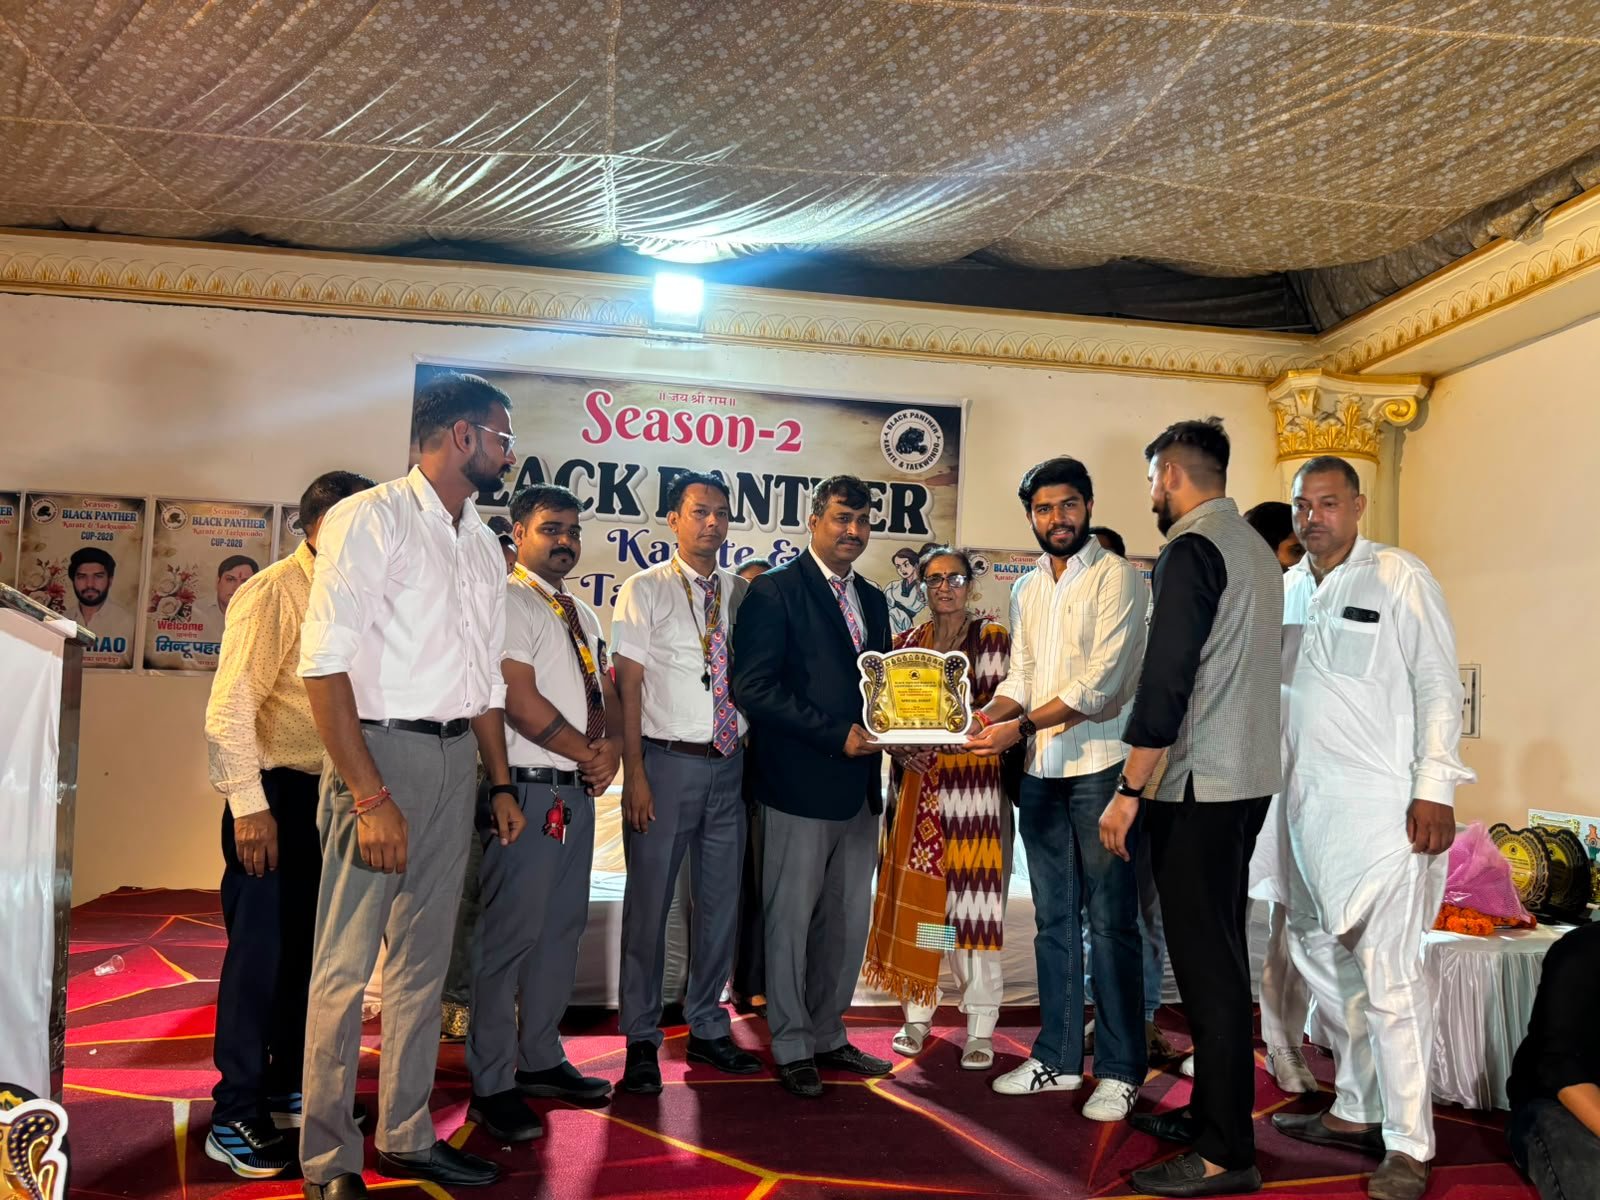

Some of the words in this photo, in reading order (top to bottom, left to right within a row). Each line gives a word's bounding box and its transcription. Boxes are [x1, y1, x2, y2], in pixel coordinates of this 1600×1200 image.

[581, 390, 802, 453] Season-2
[886, 413, 908, 431] BLACK
[909, 412, 938, 434] PANTHER
[883, 439, 897, 463] KARATE
[897, 461, 905, 469] &
[905, 442, 939, 470] TAEKWONDO
[62, 509, 92, 520] BLACK
[95, 510, 137, 522] PANTHER
[192, 516, 221, 527] BLACK
[224, 518, 266, 529] PANTHER
[607, 528, 754, 569] Kate
[993, 563, 1019, 573] BLACK
[157, 619, 204, 632] Welcome
